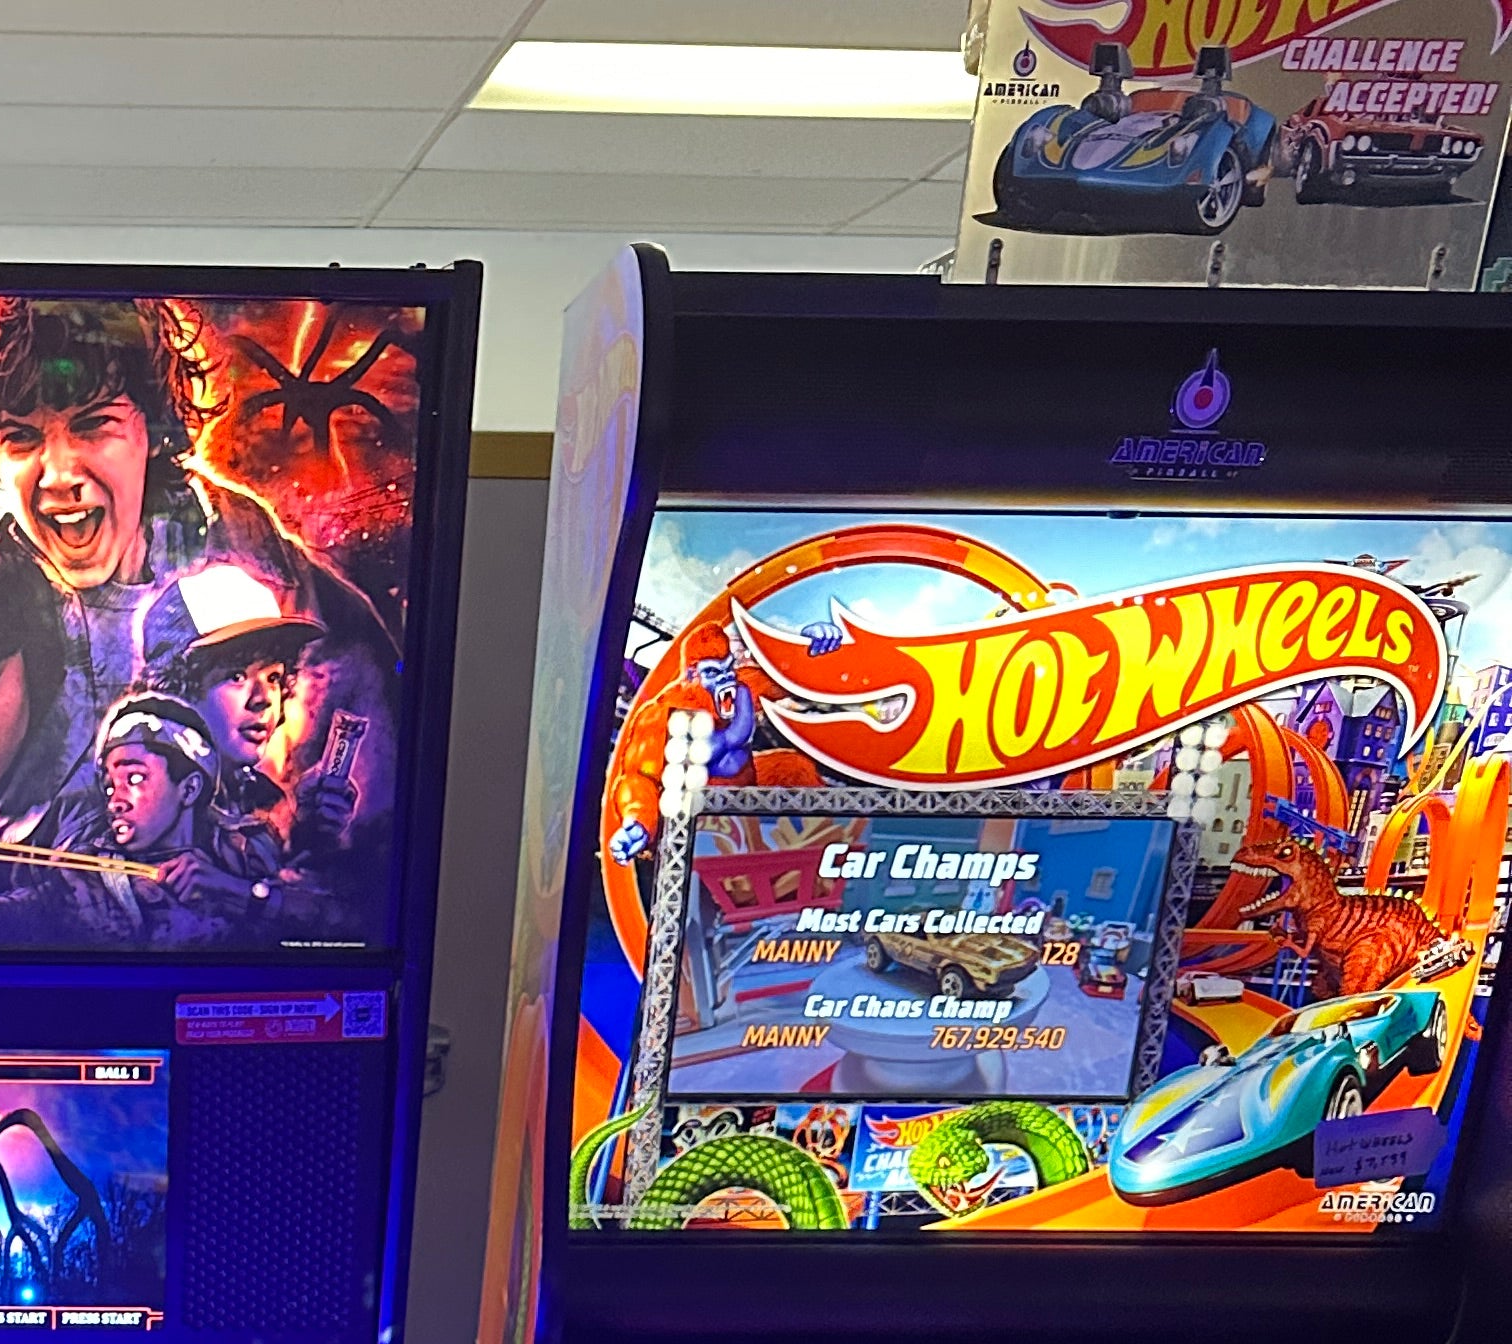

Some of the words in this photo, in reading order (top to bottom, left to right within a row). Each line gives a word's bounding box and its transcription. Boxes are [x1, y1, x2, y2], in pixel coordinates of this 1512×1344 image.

[1283, 39, 1465, 72] CHALLENGE
[983, 83, 1060, 97] AMERICAN
[1324, 81, 1499, 115] ACCEPTED!
[1110, 437, 1266, 467] AMERICAN
[889, 629, 1109, 774] HOT
[819, 843, 886, 880] Car
[889, 844, 1040, 887] Champs
[796, 908, 862, 933] Most
[864, 909, 920, 933] Cars
[923, 909, 1045, 935] Collected
[752, 939, 841, 963] MANNY
[1040, 943, 1081, 966] 128
[804, 994, 849, 1019] Car
[850, 994, 924, 1019] Chaos
[927, 995, 1014, 1024] Champ
[740, 1025, 829, 1048] MANNY
[929, 1027, 1066, 1051] 767,929,540
[95, 1066, 130, 1079] BALL
[1318, 1191, 1436, 1213] AMERICAN
[6, 1311, 48, 1324] START
[62, 1312, 101, 1325] PRESS
[101, 1312, 143, 1325] START
